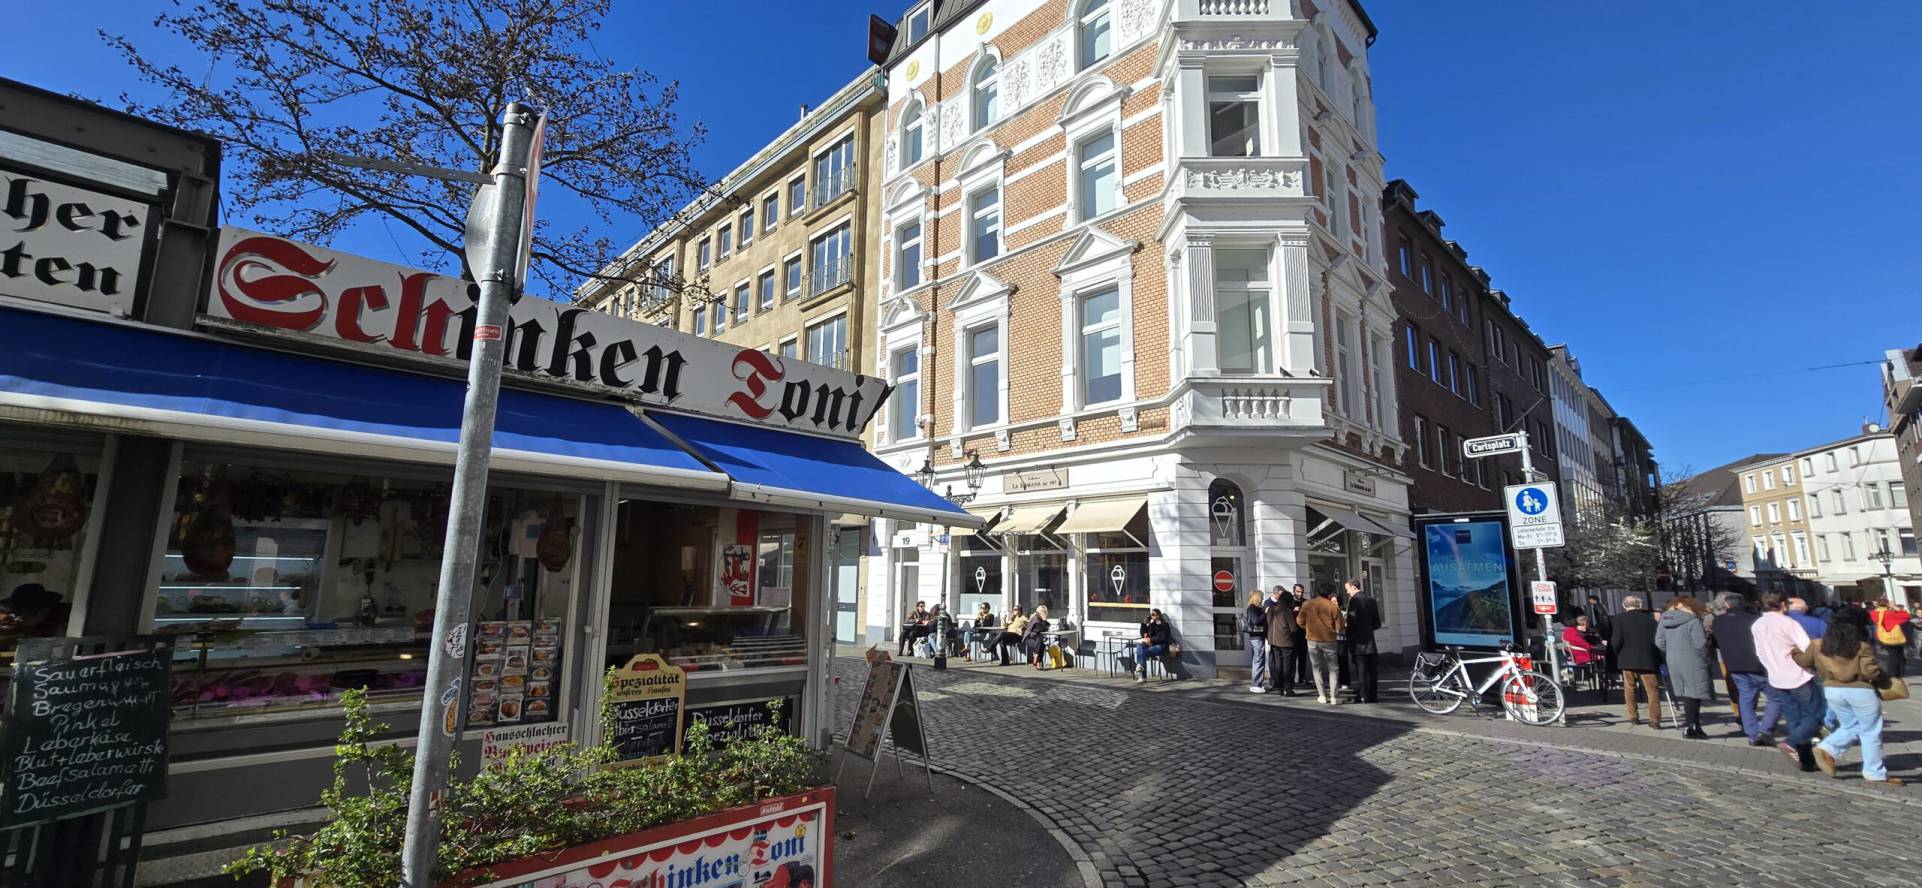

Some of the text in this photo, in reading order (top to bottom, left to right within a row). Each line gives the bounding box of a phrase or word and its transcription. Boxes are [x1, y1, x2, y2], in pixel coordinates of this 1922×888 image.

[217, 236, 864, 433] Schinken Toni
[1472, 440, 1511, 452] Carlsplatz
[1523, 516, 1547, 525] ZONE
[902, 536, 910, 545] 19
[33, 656, 163, 684] Sauerfleisch
[50, 710, 121, 735] Pinkel
[24, 729, 132, 755] Leberkäse
[484, 725, 567, 743] Hausschlachter
